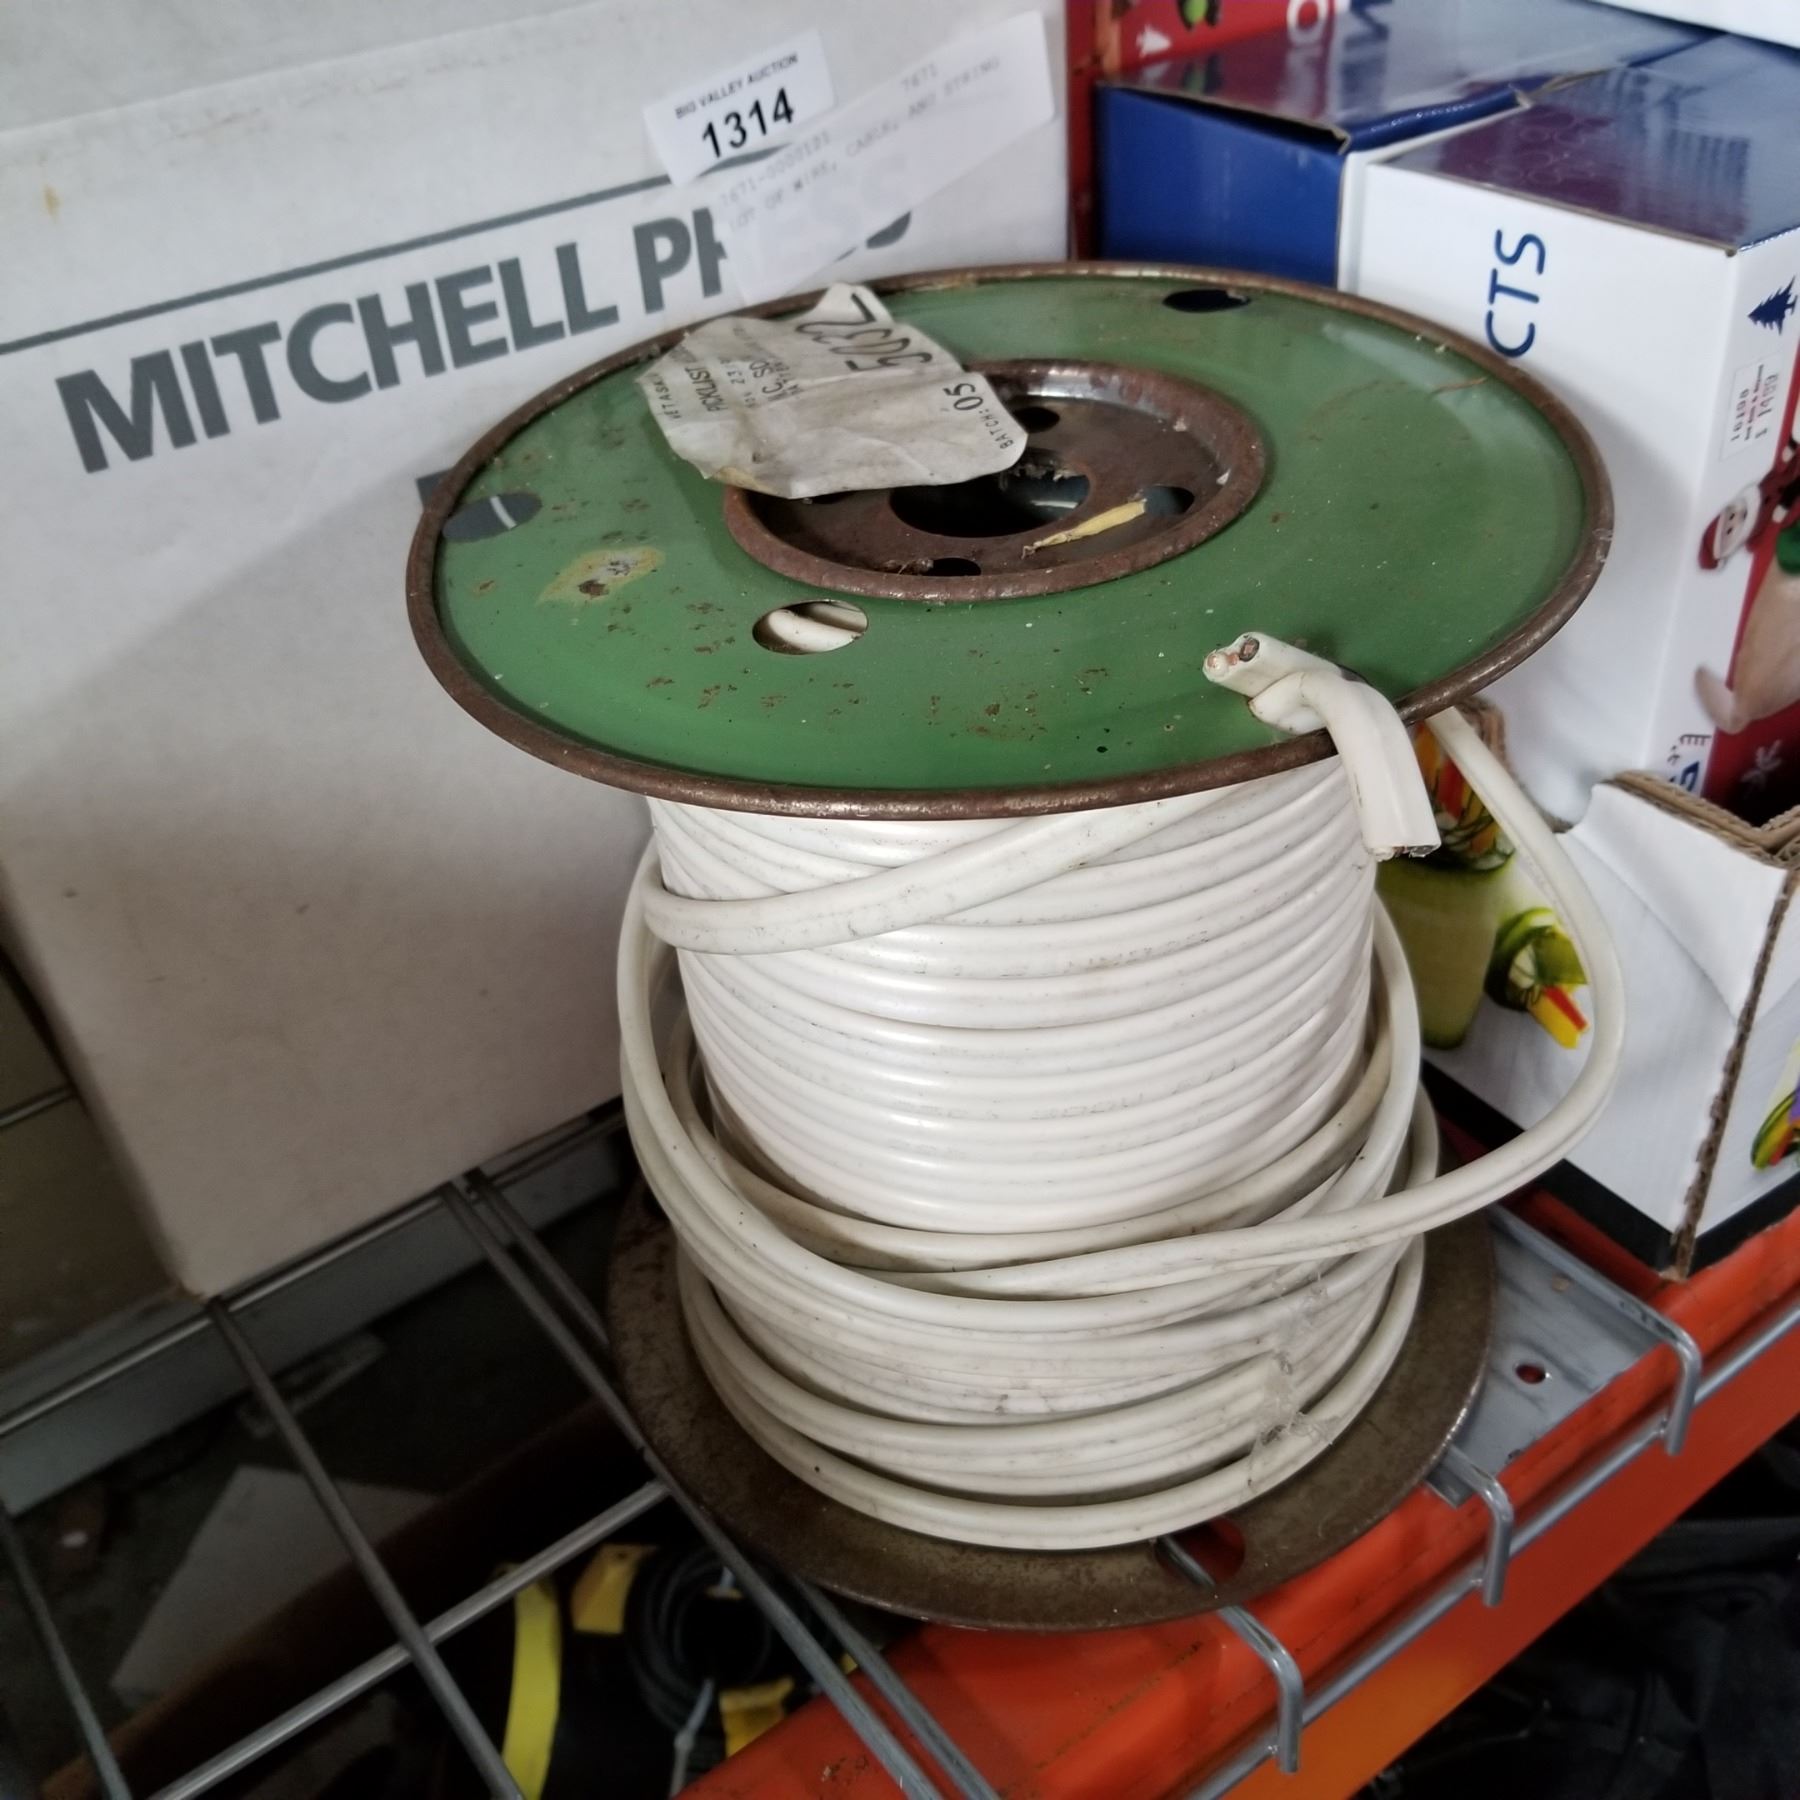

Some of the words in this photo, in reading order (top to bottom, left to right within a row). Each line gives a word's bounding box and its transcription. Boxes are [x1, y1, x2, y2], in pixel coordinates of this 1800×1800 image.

[747, 53, 799, 84] AUCTION
[702, 87, 795, 159] 1314
[56, 242, 618, 474] MITCHELL
[942, 383, 984, 411] 05
